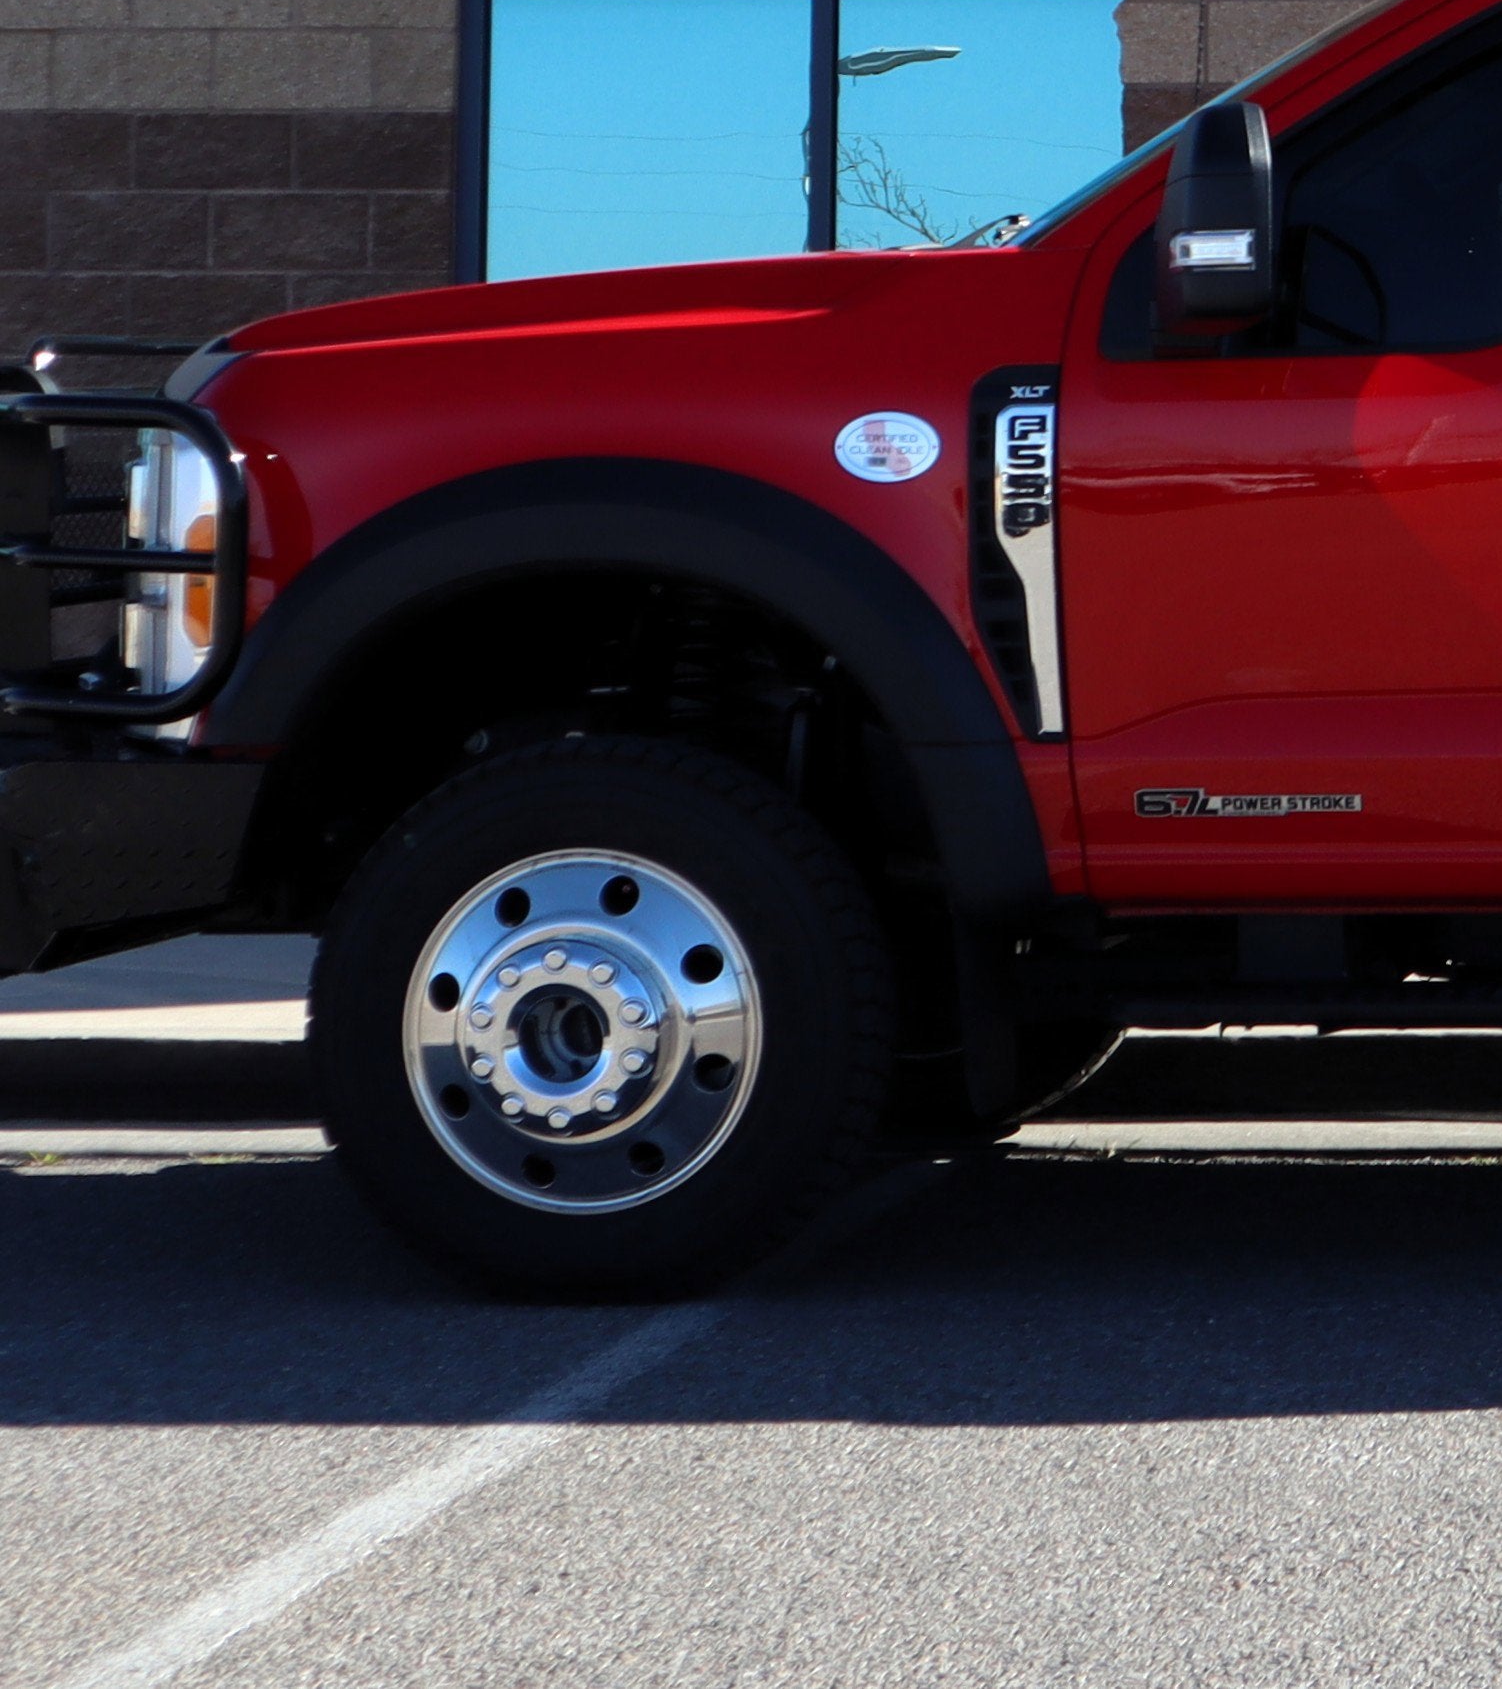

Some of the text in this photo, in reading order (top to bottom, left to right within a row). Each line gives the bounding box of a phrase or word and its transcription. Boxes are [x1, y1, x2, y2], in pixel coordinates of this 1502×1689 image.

[1010, 385, 1051, 399] XLT
[856, 434, 918, 444] CERTIFIED
[849, 446, 925, 455] CLEAN IDLE
[1221, 797, 1281, 810] POWER
[1287, 796, 1356, 810] STROKE
